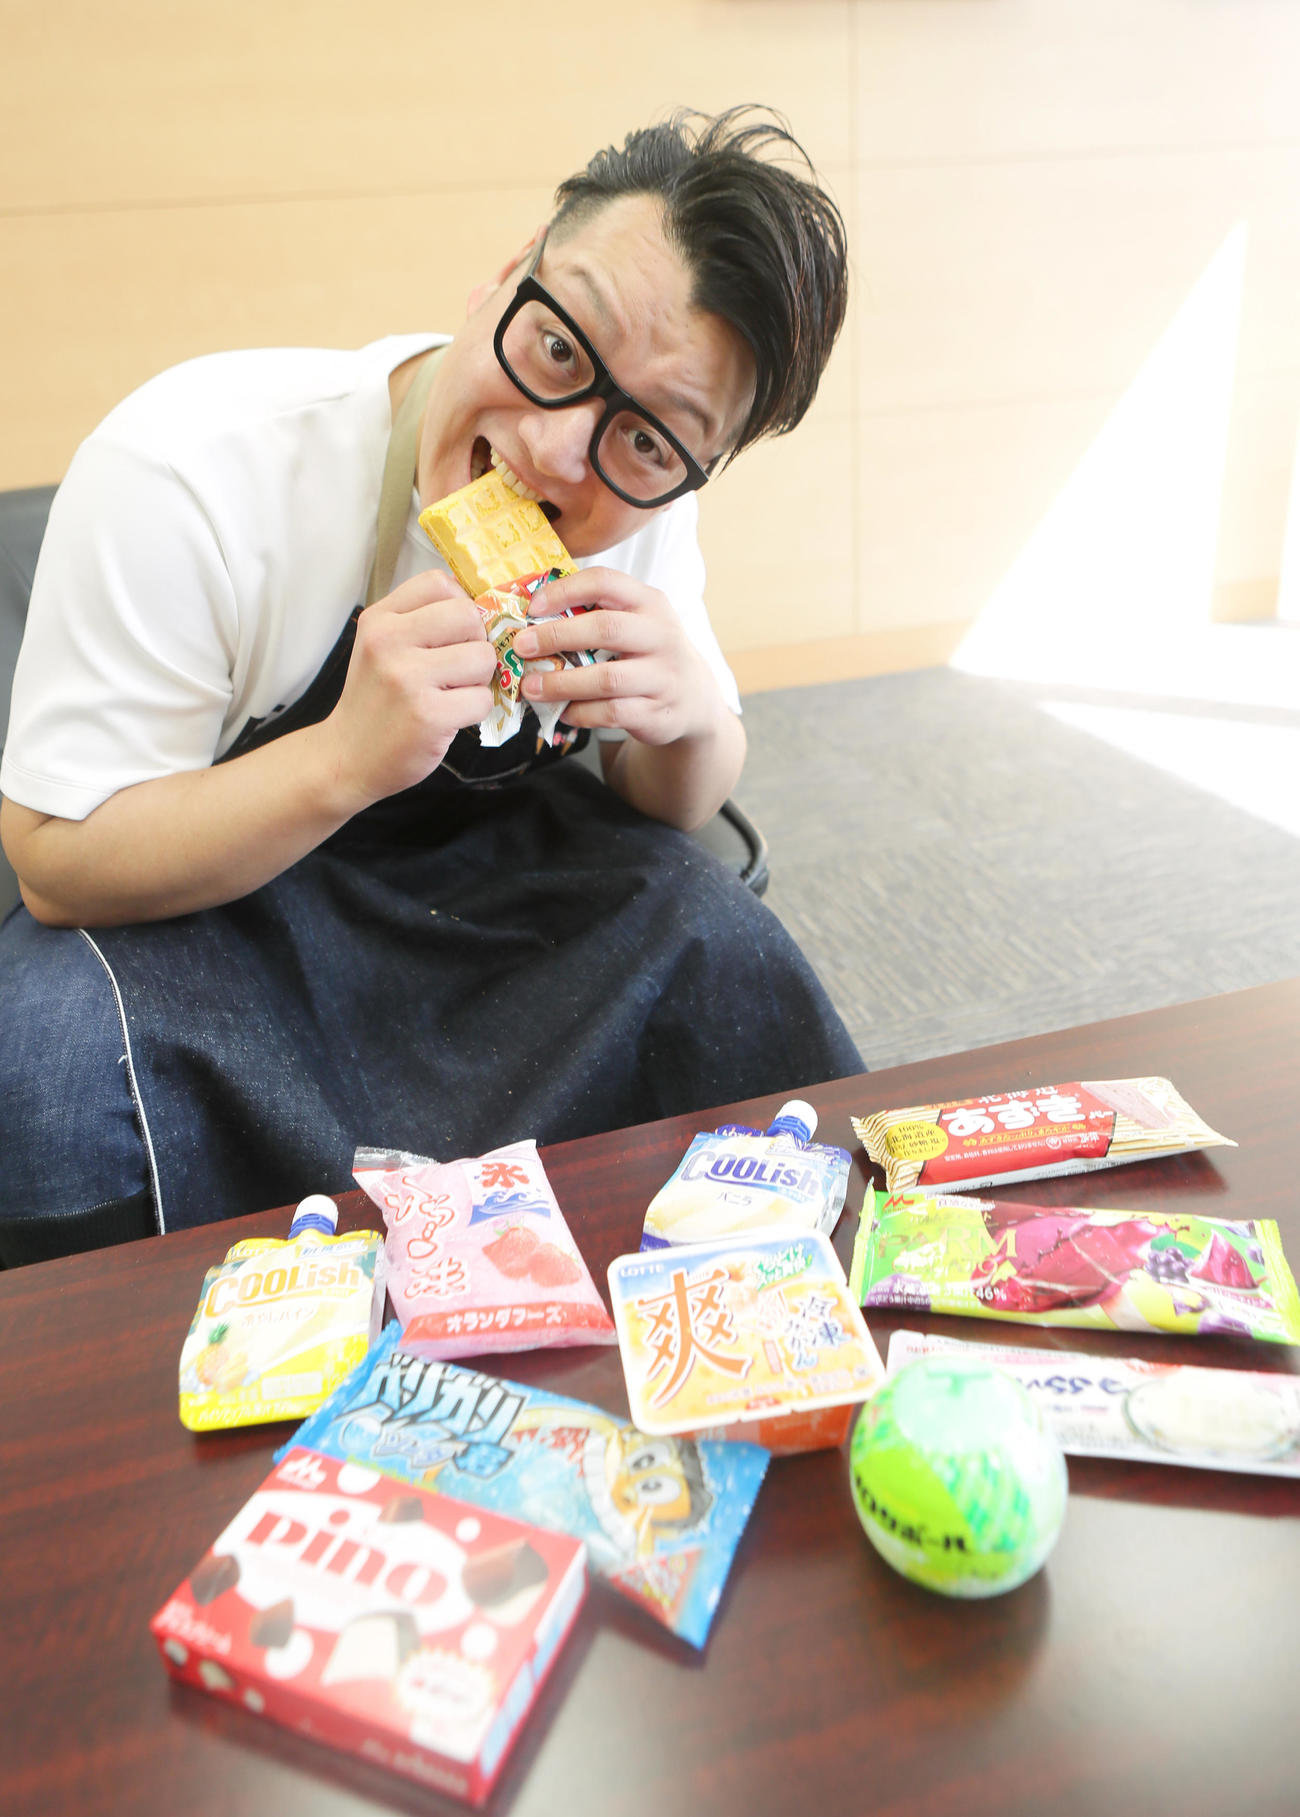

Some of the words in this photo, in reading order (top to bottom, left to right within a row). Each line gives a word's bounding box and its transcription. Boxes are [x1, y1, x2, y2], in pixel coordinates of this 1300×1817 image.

[942, 1093, 1087, 1137] あずき
[481, 1161, 530, 1189] 氷
[620, 1263, 664, 1278] LOTTE
[446, 1306, 563, 1334] オランダフーズ
[637, 1268, 747, 1404] 爽
[334, 1353, 528, 1445] ガリガリ
[245, 1508, 449, 1606] pino
